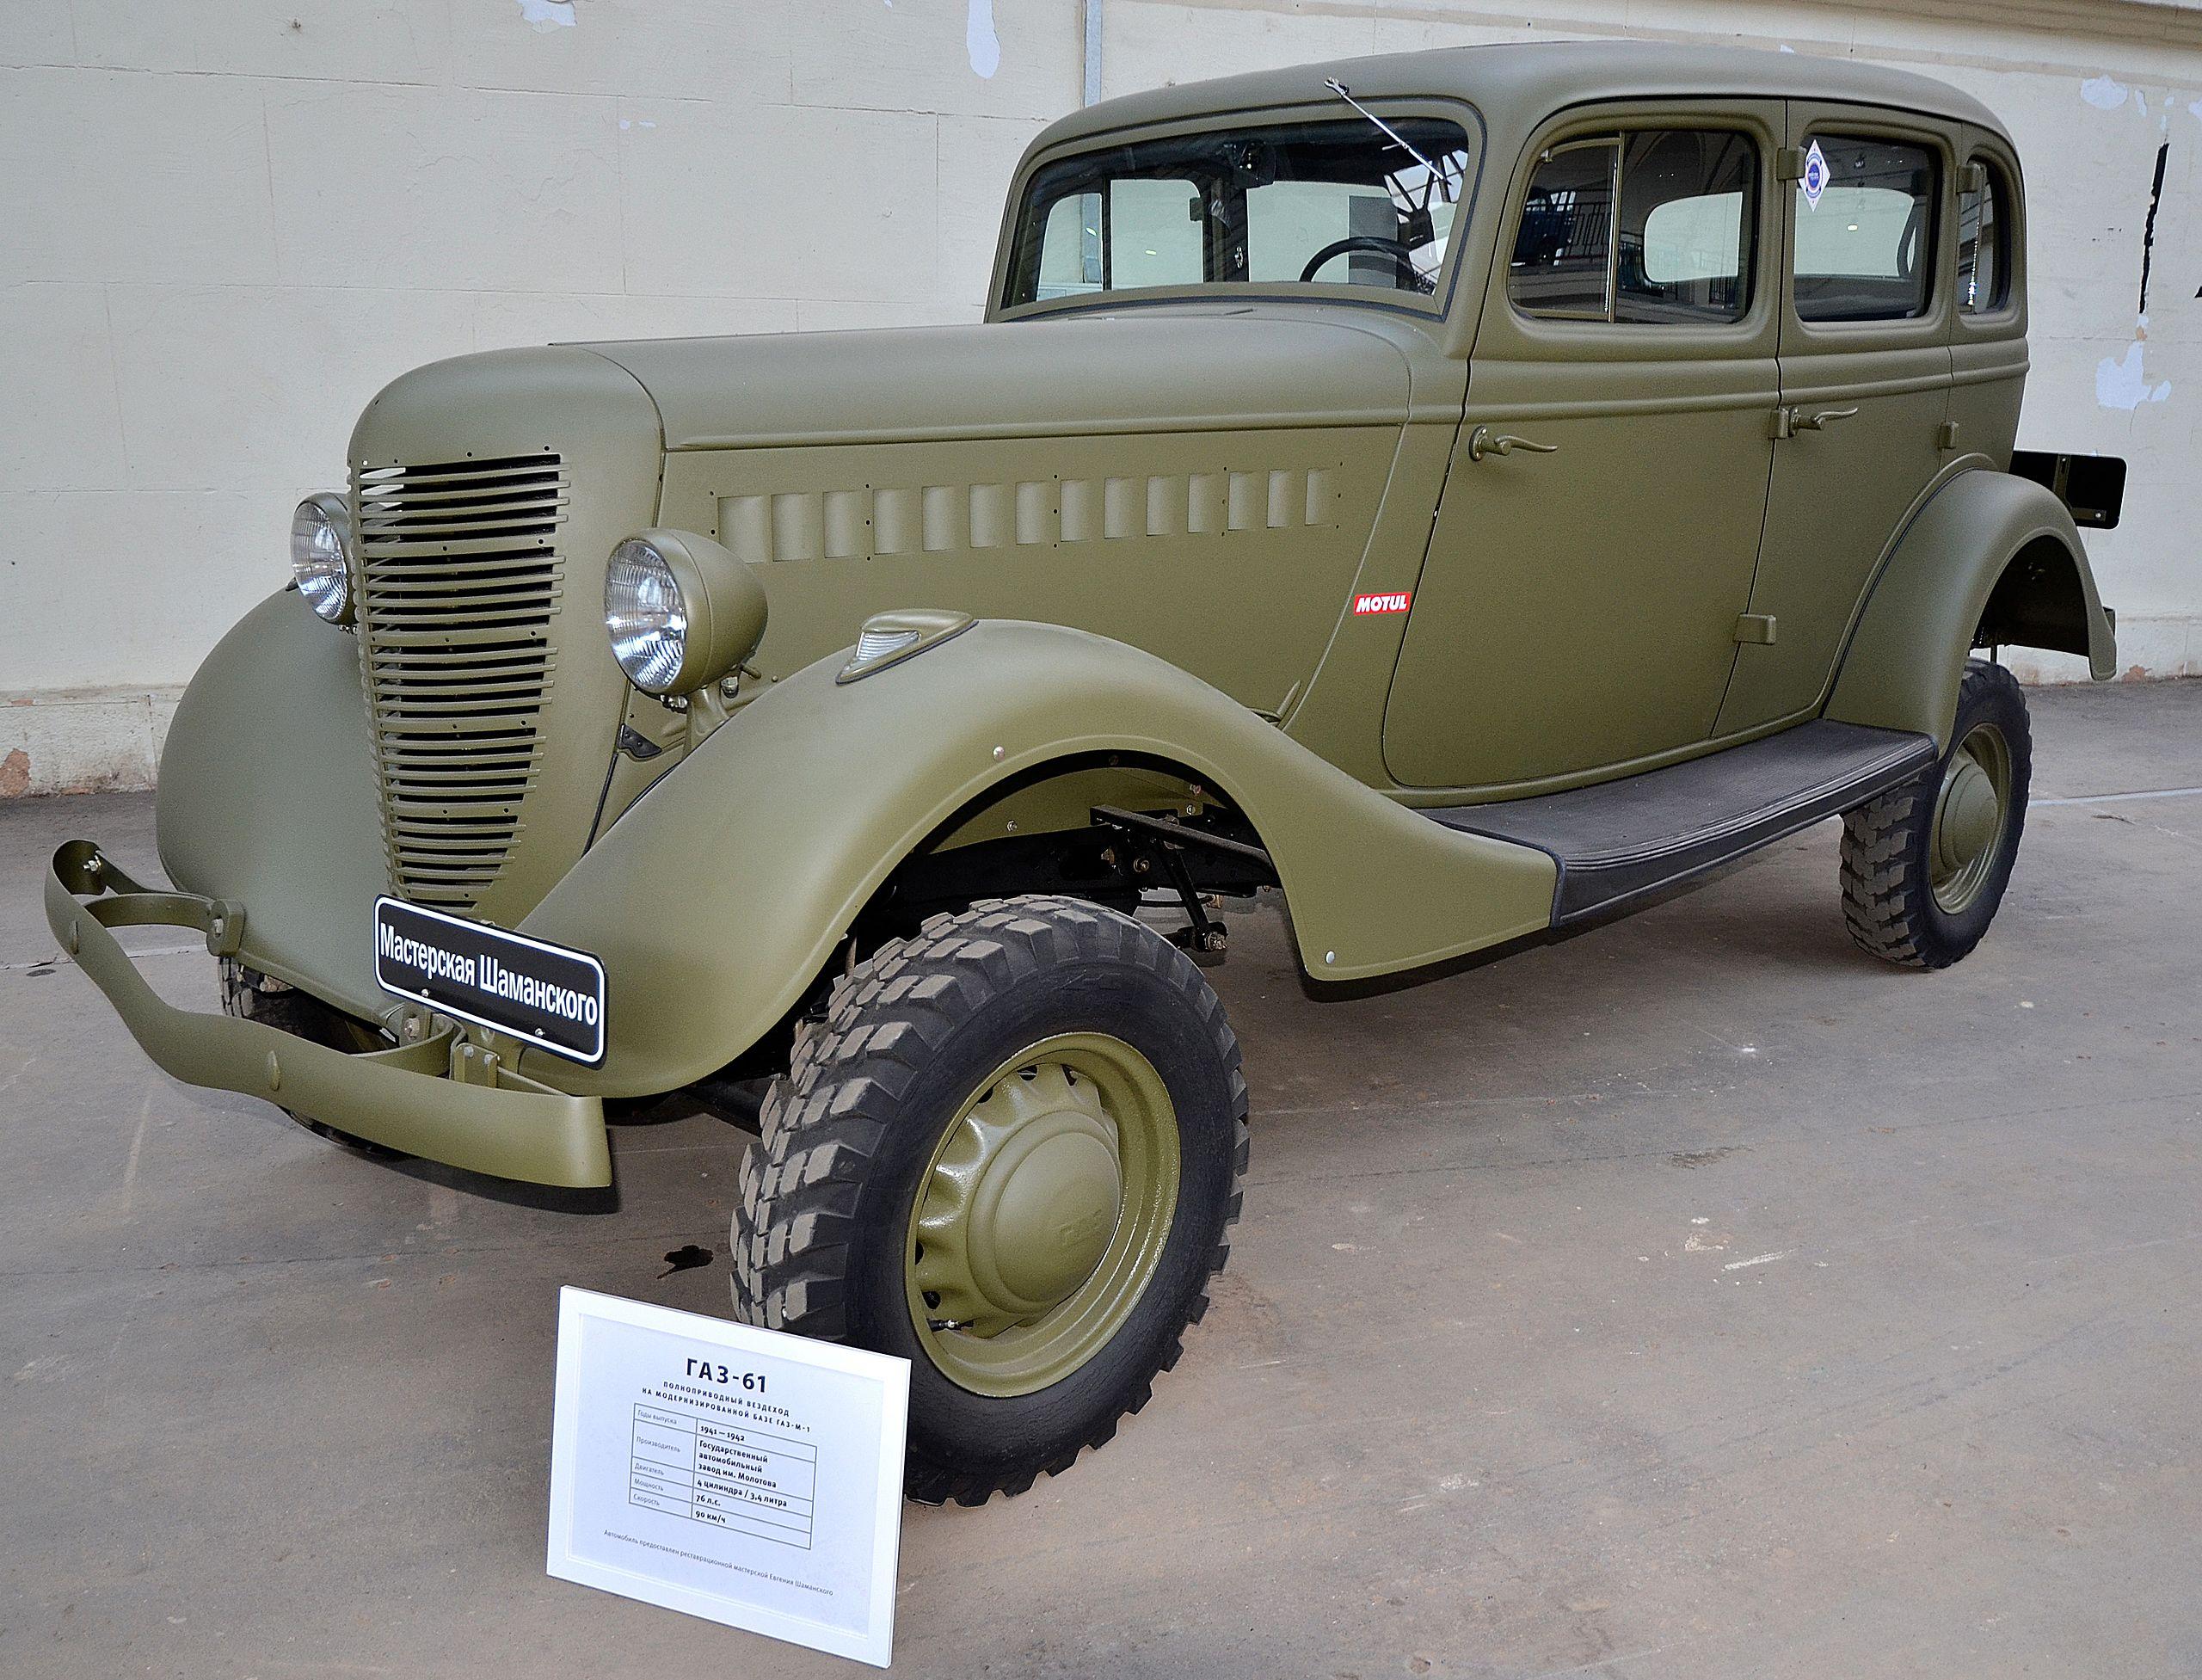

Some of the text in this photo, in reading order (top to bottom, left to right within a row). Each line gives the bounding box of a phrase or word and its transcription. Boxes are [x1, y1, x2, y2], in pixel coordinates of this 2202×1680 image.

[1356, 595, 1407, 612] MOTUL
[380, 922, 598, 1026] Мастерская Шаманского
[686, 1357, 766, 1394] ГАЗ-61
[663, 1381, 790, 1417] ПОЛНОПРИВОДНЫЙ ВЕЗДЕХОД
[637, 1409, 677, 1425] Годы выпуска
[655, 1391, 749, 1418] МОДЕРНИЗИРОВАННОЙ
[753, 1413, 773, 1424] БАЗЕ
[776, 1419, 810, 1432] ГАЗ-М-1
[700, 1425, 717, 1436] 1941
[727, 1432, 745, 1442] 1942
[637, 1436, 680, 1454] Производитель
[699, 1440, 768, 1463] Государственный
[635, 1462, 664, 1476] Двигатель
[699, 1453, 762, 1473] автомобильный
[634, 1478, 664, 1492] Мощность
[698, 1463, 777, 1488] завод им. Молотова
[633, 1493, 660, 1506] Скорость
[696, 1494, 721, 1506] 76 л.с.
[704, 1481, 742, 1496] цилиндра
[763, 1495, 787, 1507] литра
[695, 1511, 726, 1523] 90 км/ч
[604, 1529, 638, 1544] Автомобиль
[639, 1540, 680, 1554] предоставлен
[734, 1564, 768, 1579] мастерской
[795, 1580, 833, 1596] Шаманского
